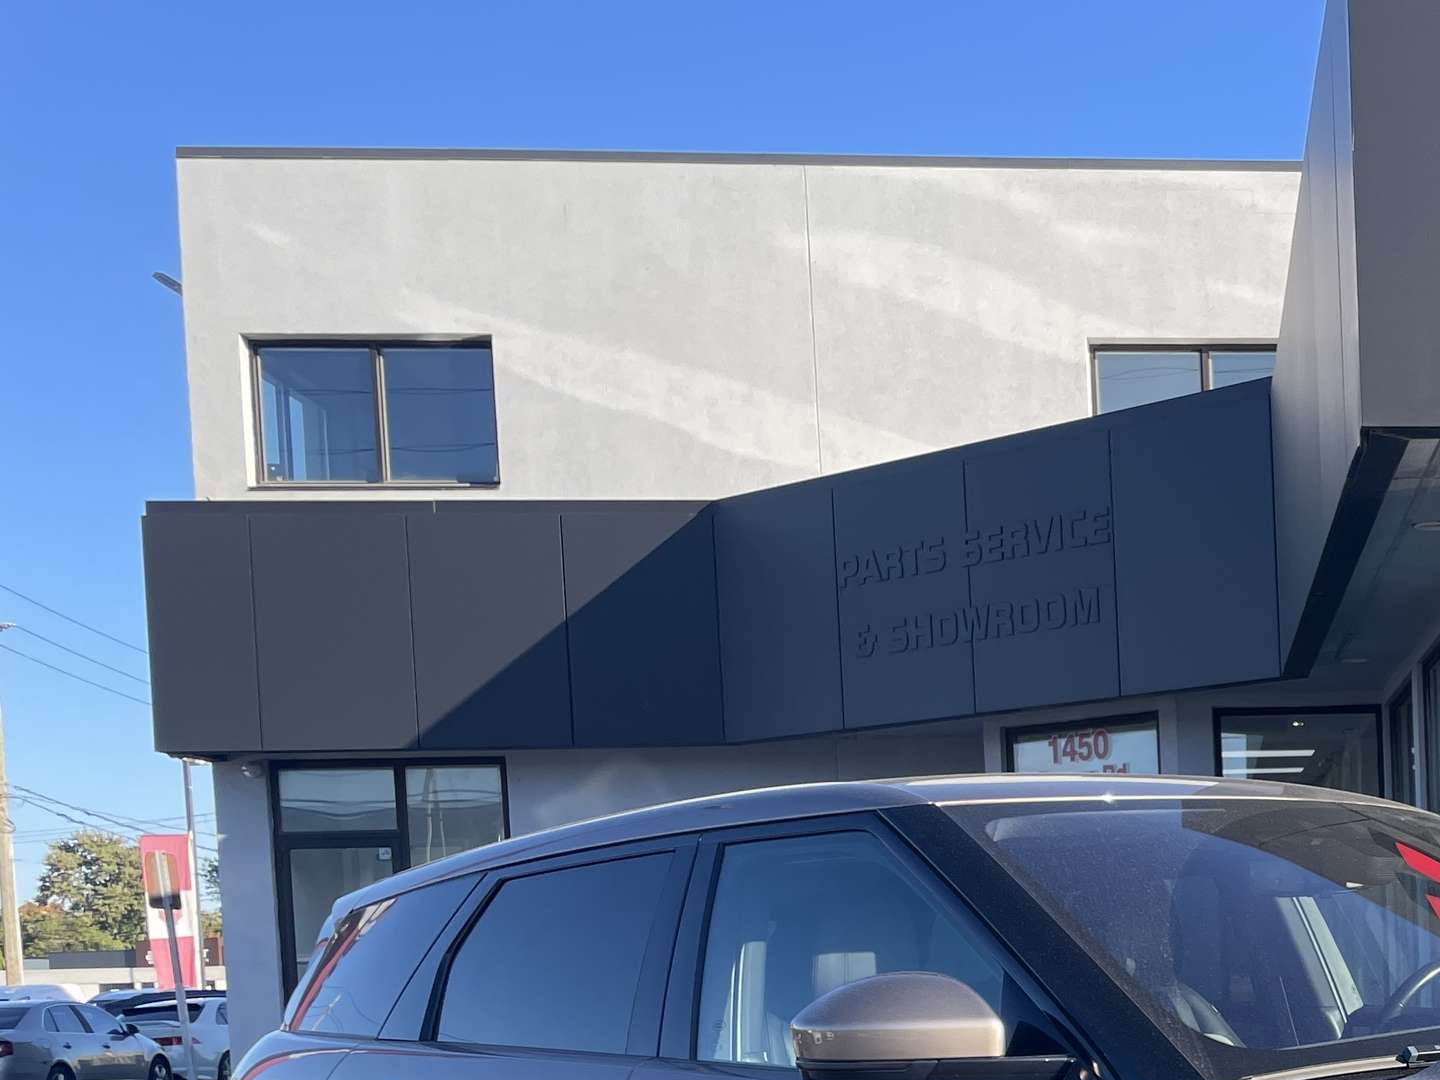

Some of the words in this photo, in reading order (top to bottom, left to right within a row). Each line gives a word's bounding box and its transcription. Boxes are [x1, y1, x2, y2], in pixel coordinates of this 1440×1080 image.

[838, 535, 948, 589] PARTS
[961, 505, 1113, 569] SERVICE
[856, 623, 879, 659] &
[888, 584, 1102, 655] SHOWROOM
[1048, 728, 1111, 764] 1450
